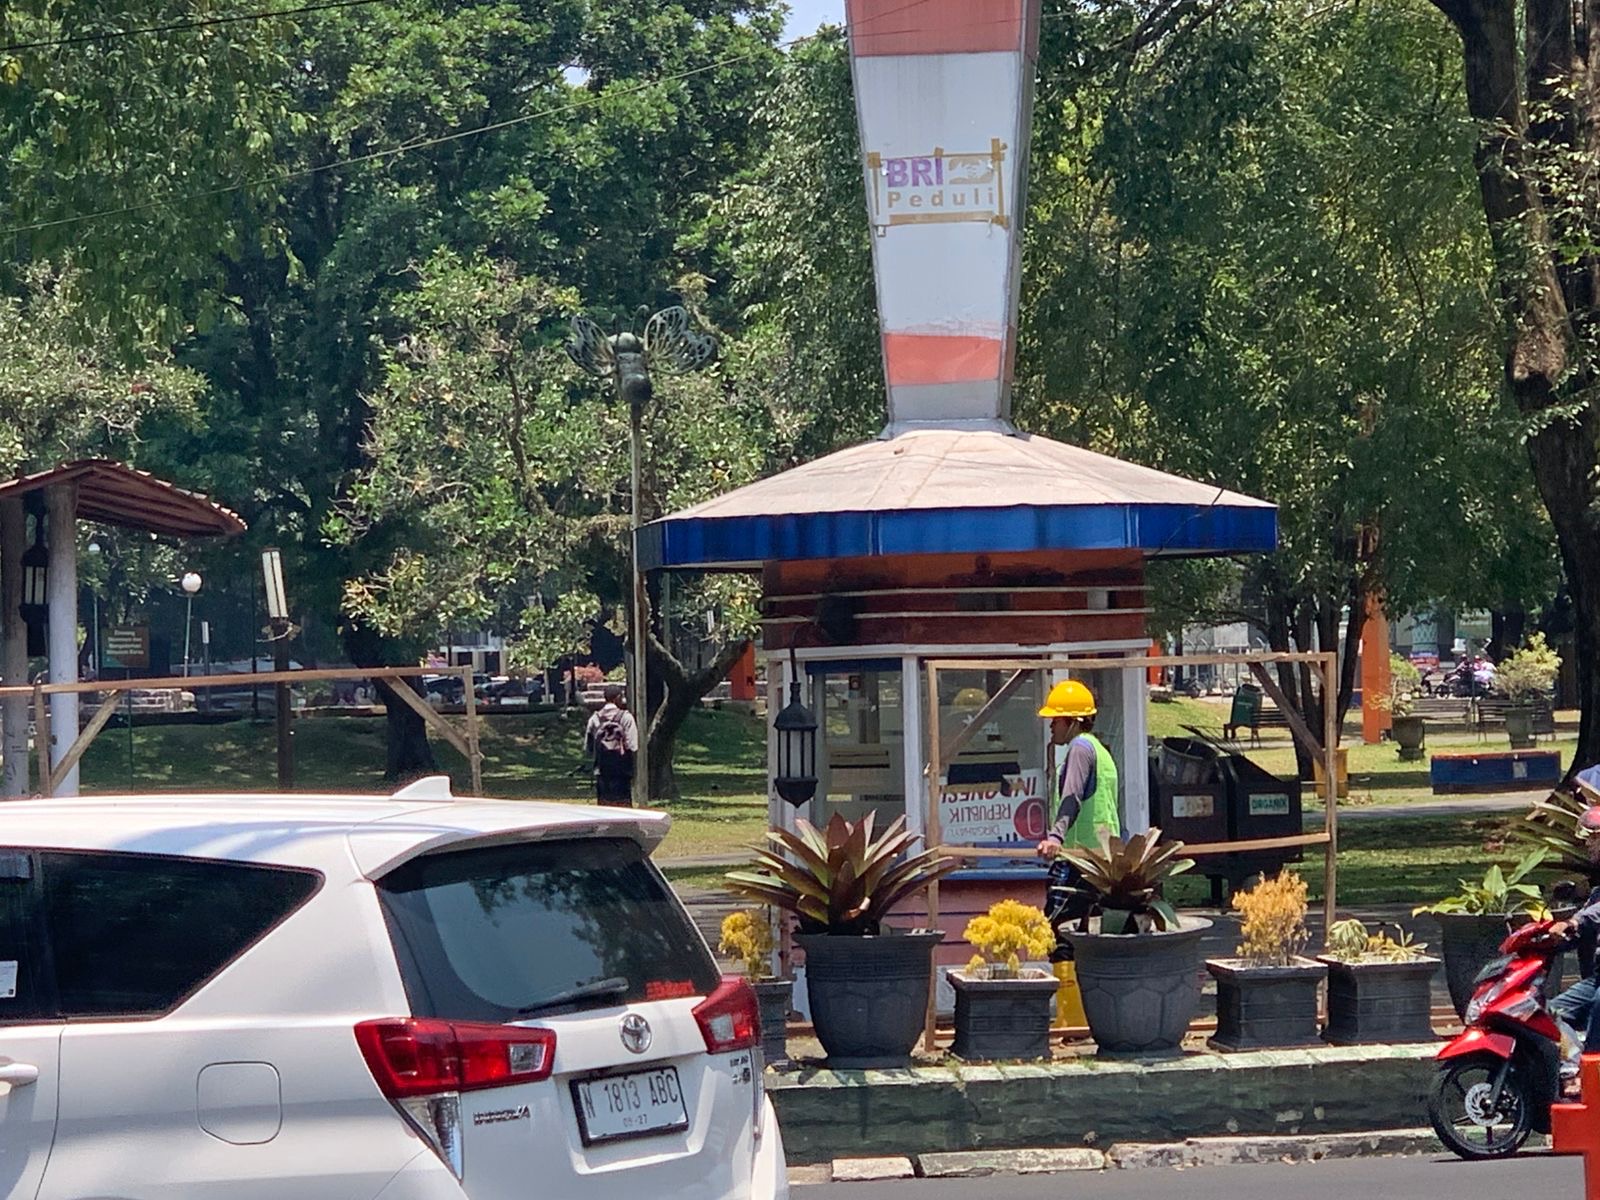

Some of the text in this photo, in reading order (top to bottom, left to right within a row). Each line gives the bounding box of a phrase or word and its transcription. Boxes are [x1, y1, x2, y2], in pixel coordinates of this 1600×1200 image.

[887, 157, 944, 188] BRI
[888, 187, 994, 209] Peduli
[949, 803, 1011, 824] REPUBLIK
[582, 1074, 679, 1119] N 1813 ABC
